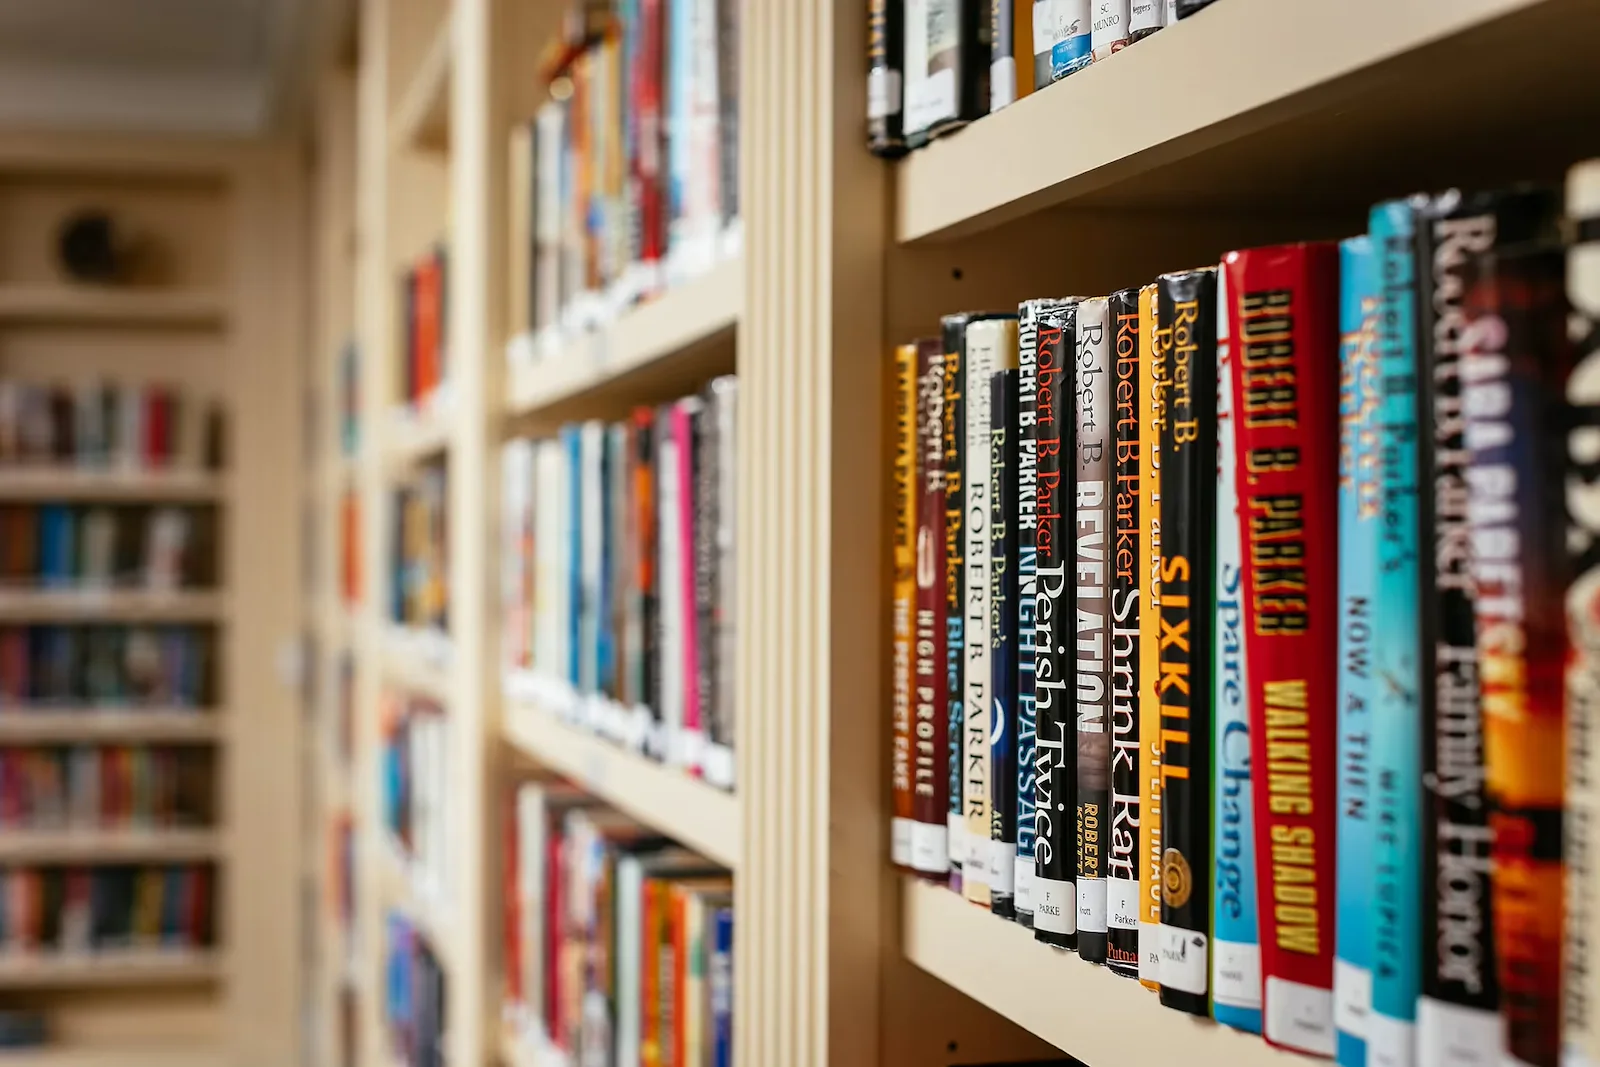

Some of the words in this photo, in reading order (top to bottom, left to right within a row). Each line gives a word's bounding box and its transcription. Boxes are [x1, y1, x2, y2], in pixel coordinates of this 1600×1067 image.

[1093, 14, 1120, 33] MUNRO
[1100, 3, 1109, 14] SC
[1037, 327, 1062, 426] Robert
[1082, 321, 1103, 432] Robert
[1117, 312, 1139, 432] Robert
[1157, 326, 1174, 431] Parker
[1174, 300, 1199, 408] Robert
[1239, 290, 1297, 429] ROBERT
[944, 351, 961, 461] Robert
[1037, 437, 1061, 463] B.
[1082, 438, 1103, 471] B.
[1117, 438, 1139, 467] B.
[1174, 419, 1199, 452] B.
[991, 428, 1005, 512] Robert
[1019, 439, 1036, 529] PARKER
[1037, 468, 1061, 557] Parker
[1246, 447, 1301, 485] B.
[946, 509, 963, 608] Parker
[970, 483, 984, 624] ROBERT
[1116, 472, 1140, 585] Parker
[1248, 494, 1308, 636] PARKER
[916, 610, 935, 675] HIGH
[991, 554, 1007, 649] Parker's
[1036, 560, 1066, 709] Perish
[1077, 480, 1104, 733] REVELATION
[1218, 564, 1242, 706] Spare
[1346, 596, 1370, 680] NOW
[947, 616, 963, 692] Blue
[1112, 588, 1140, 773] Shrink
[1160, 555, 1191, 788] SIXKILL
[915, 686, 934, 797] PROFILE
[969, 682, 983, 820] PARKER
[1017, 695, 1036, 859] PASSAG
[1263, 679, 1313, 814] WALKING
[1344, 732, 1368, 821] THEN
[1035, 720, 1066, 866] Twice
[1084, 802, 1099, 880] ROBERT
[1217, 720, 1251, 920] Change
[1038, 903, 1060, 916] PARKE
[1046, 892, 1051, 902] F
[1114, 913, 1137, 926] Parker
[1121, 900, 1125, 909] F
[1270, 825, 1320, 954] SHADOW
[1436, 818, 1496, 994] Honor
